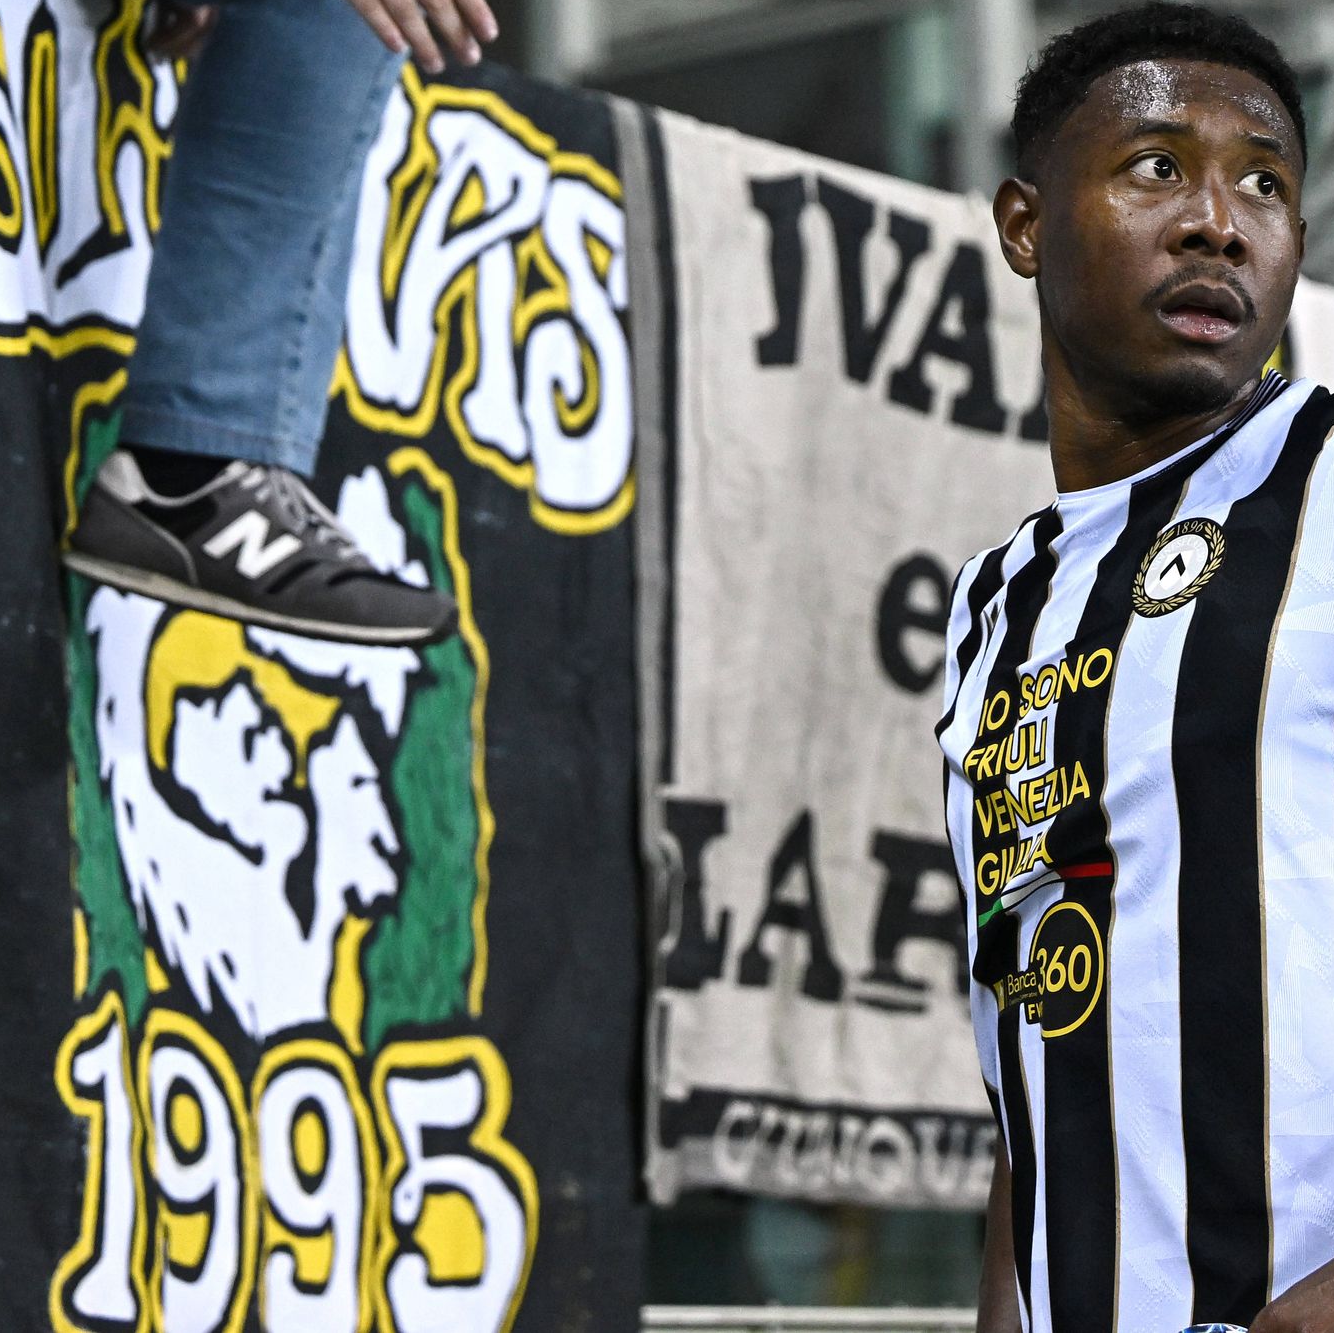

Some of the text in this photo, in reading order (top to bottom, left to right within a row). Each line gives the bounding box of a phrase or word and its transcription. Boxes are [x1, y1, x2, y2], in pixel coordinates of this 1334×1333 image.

[747, 172, 1051, 446] IVA
[1176, 519, 1207, 536] 1896
[978, 647, 1113, 737] IO SONO
[964, 719, 1047, 782] FRIULI
[975, 760, 1091, 839] VENEZIA
[1007, 944, 1092, 996] Banca 360
[50, 991, 541, 1333] 1995
